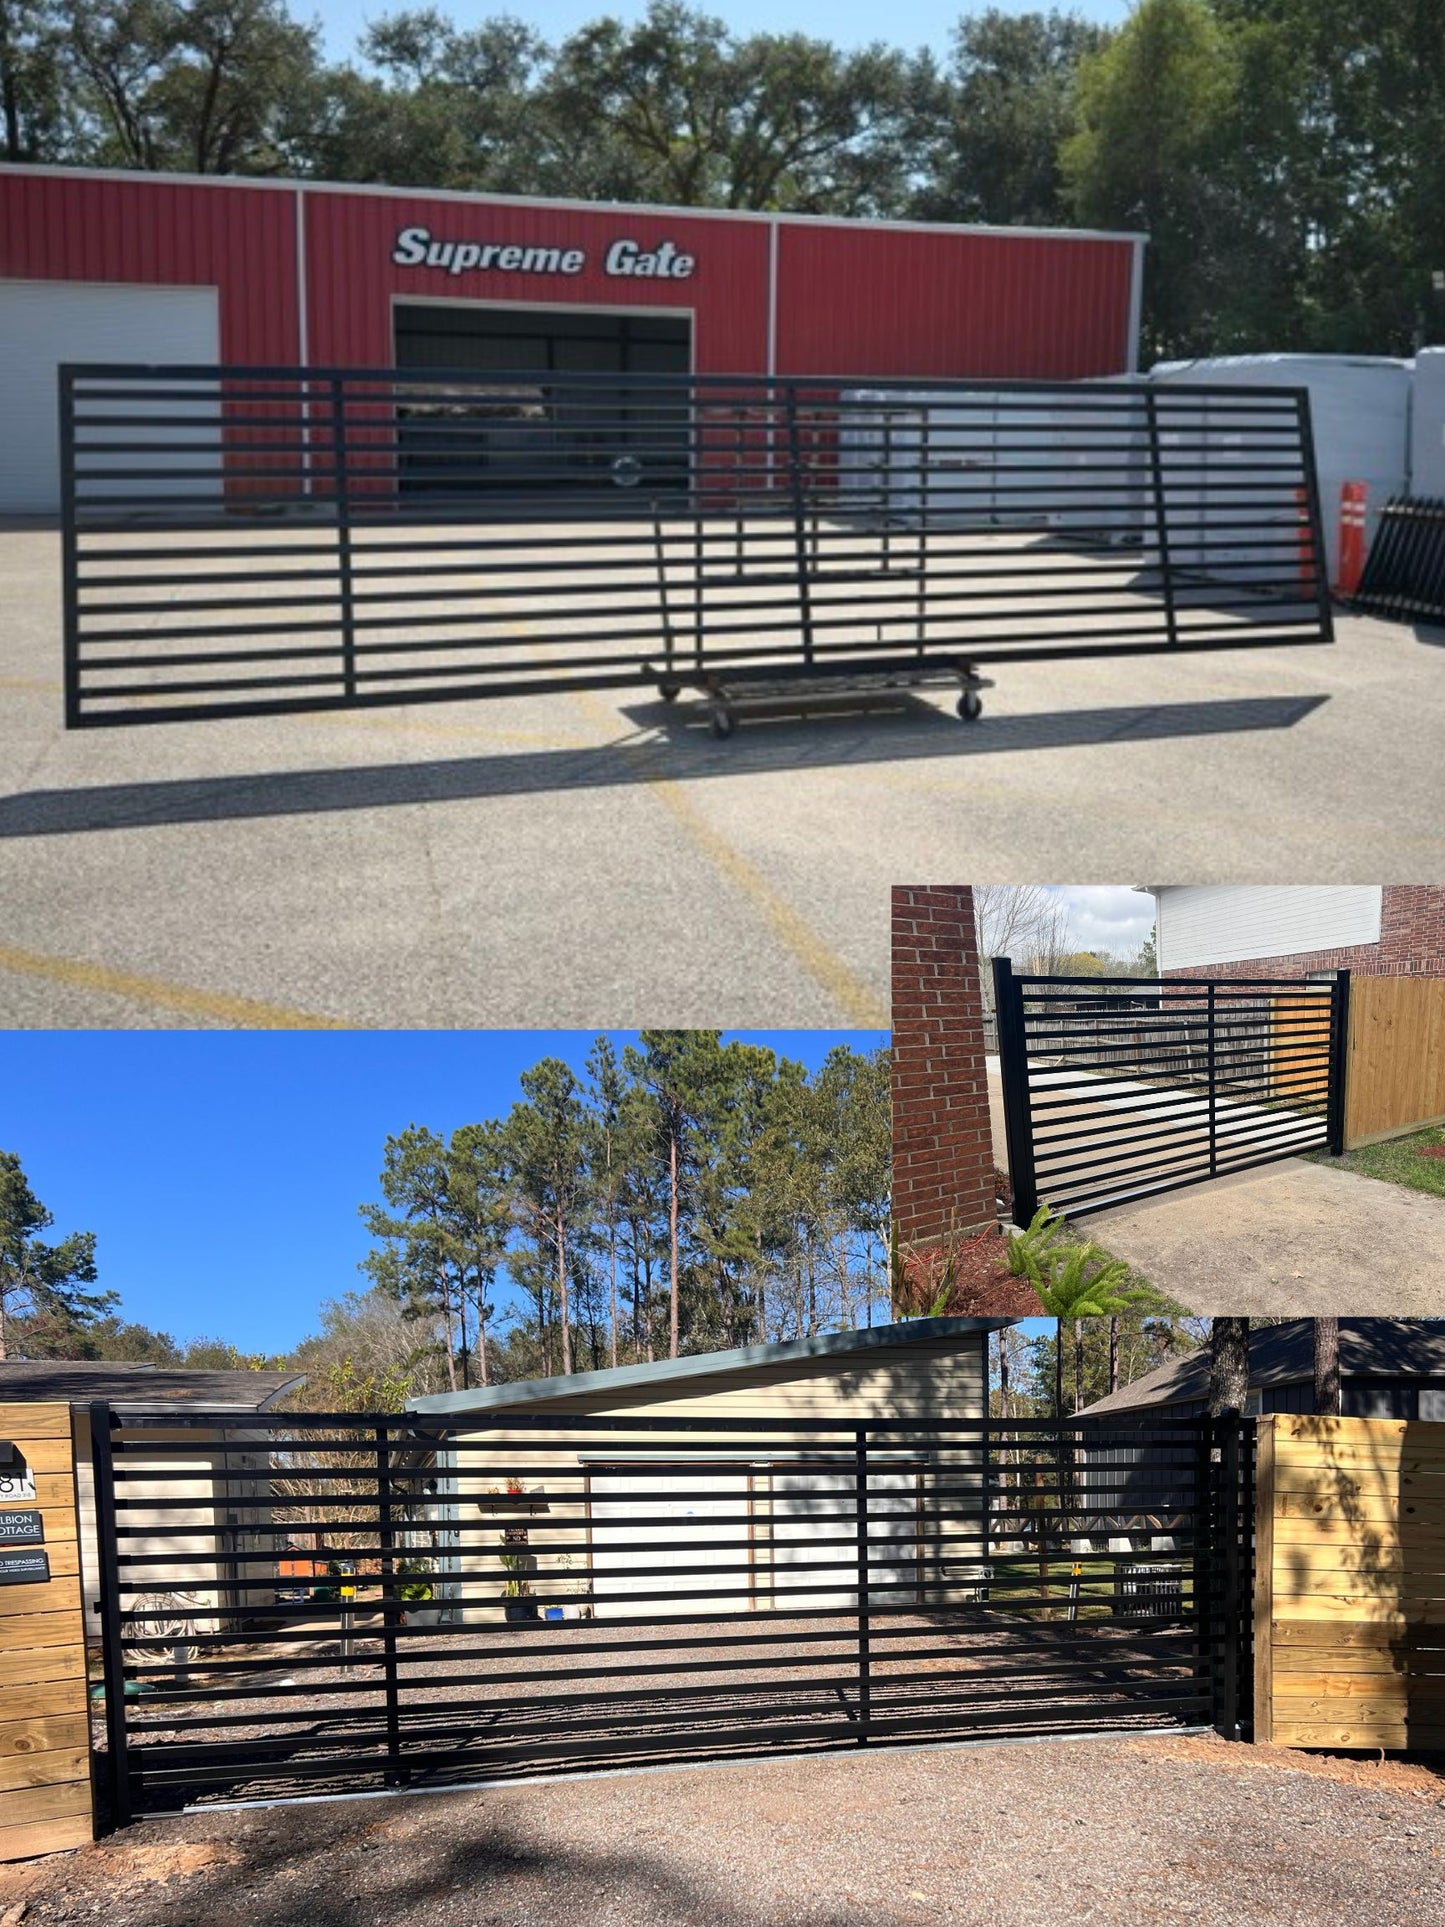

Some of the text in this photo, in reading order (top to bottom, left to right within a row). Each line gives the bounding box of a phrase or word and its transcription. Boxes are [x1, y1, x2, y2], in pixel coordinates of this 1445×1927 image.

[392, 227, 696, 278] Supreme Gate
[0, 1515, 32, 1524] LBION
[0, 1525, 40, 1535] OTTAGE
